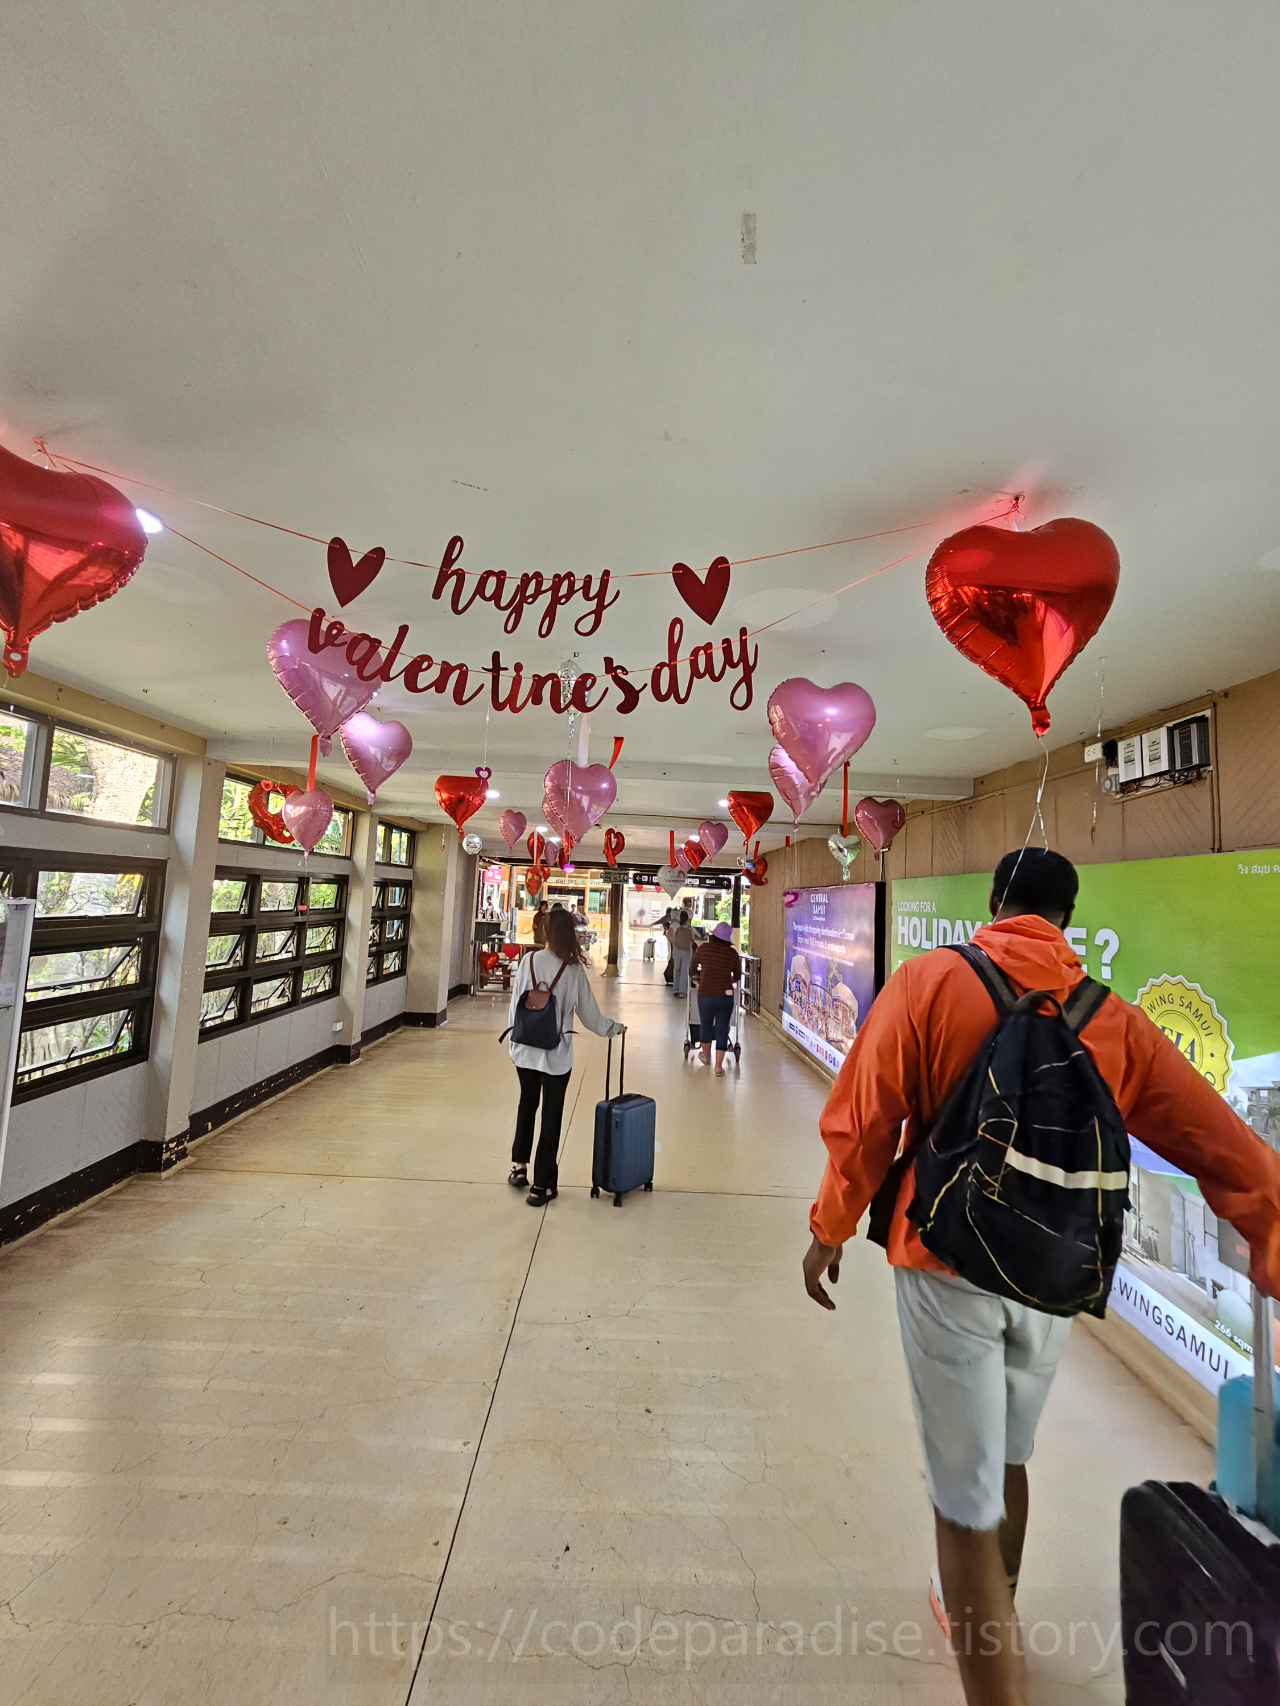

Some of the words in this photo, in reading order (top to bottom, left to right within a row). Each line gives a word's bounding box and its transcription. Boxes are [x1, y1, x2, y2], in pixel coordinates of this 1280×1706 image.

[432, 535, 620, 638] happy
[307, 607, 647, 715] valentine's
[650, 617, 759, 711] day
[810, 893, 829, 903] CENTRAL
[812, 905, 826, 915] SAMUI
[897, 901, 919, 912] LOOKING
[920, 902, 931, 913] FOR
[931, 902, 937, 913] A
[897, 916, 982, 950] HOLIDAY
[1147, 993, 1174, 1013] WING
[1179, 996, 1214, 1037] SAMUI
[1214, 1320, 1232, 1338] 266
[1232, 1335, 1253, 1354] sqm
